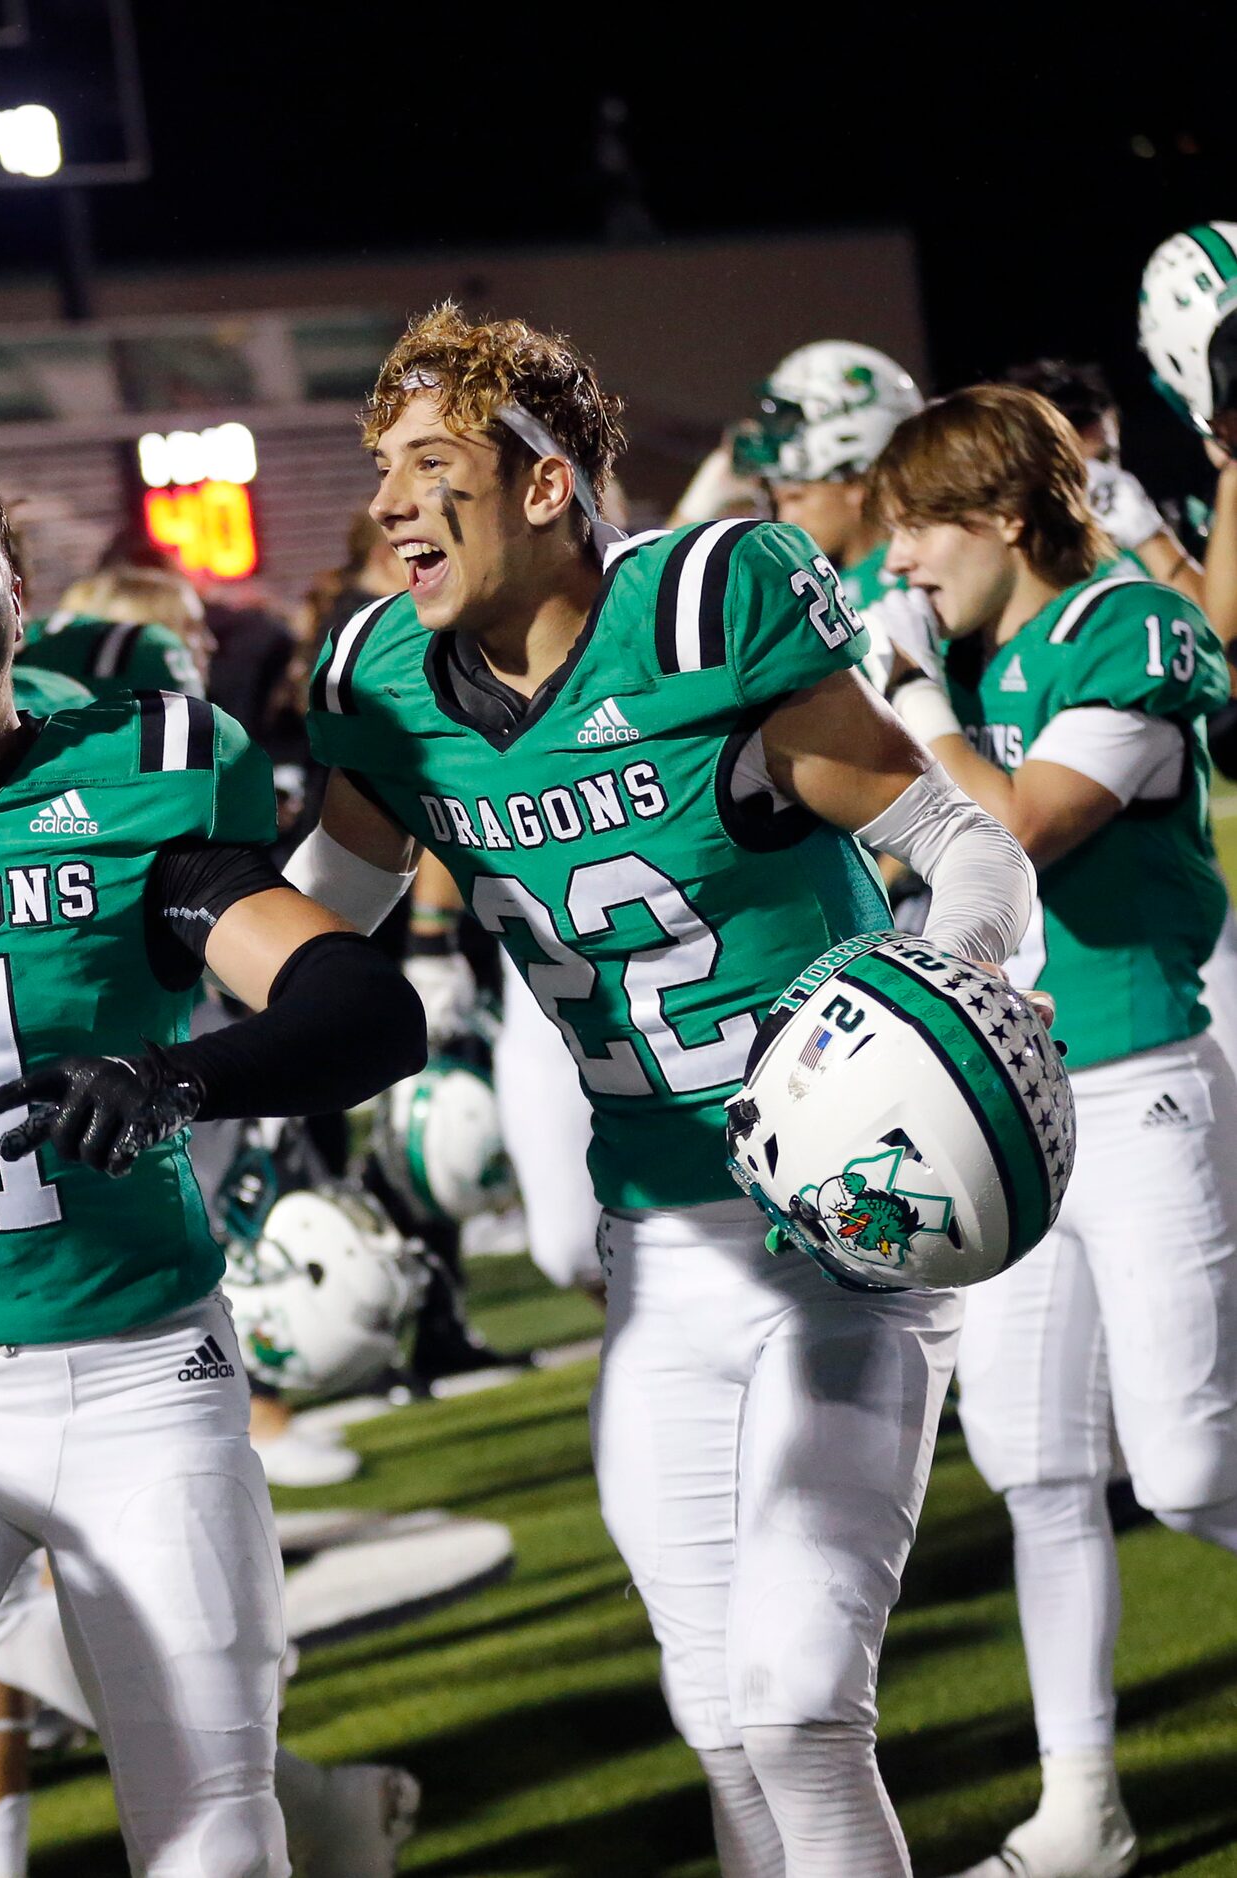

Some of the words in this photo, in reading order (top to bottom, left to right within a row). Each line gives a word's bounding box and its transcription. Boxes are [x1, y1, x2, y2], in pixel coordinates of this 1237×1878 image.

[789, 554, 865, 650] 22
[1144, 614, 1196, 683] 13
[577, 724, 640, 744] adidas
[29, 814, 99, 835] adidas
[419, 759, 670, 851] DRAGONS
[471, 851, 760, 1094] 22
[820, 994, 866, 1034] 2
[178, 1362, 235, 1382] adidas
